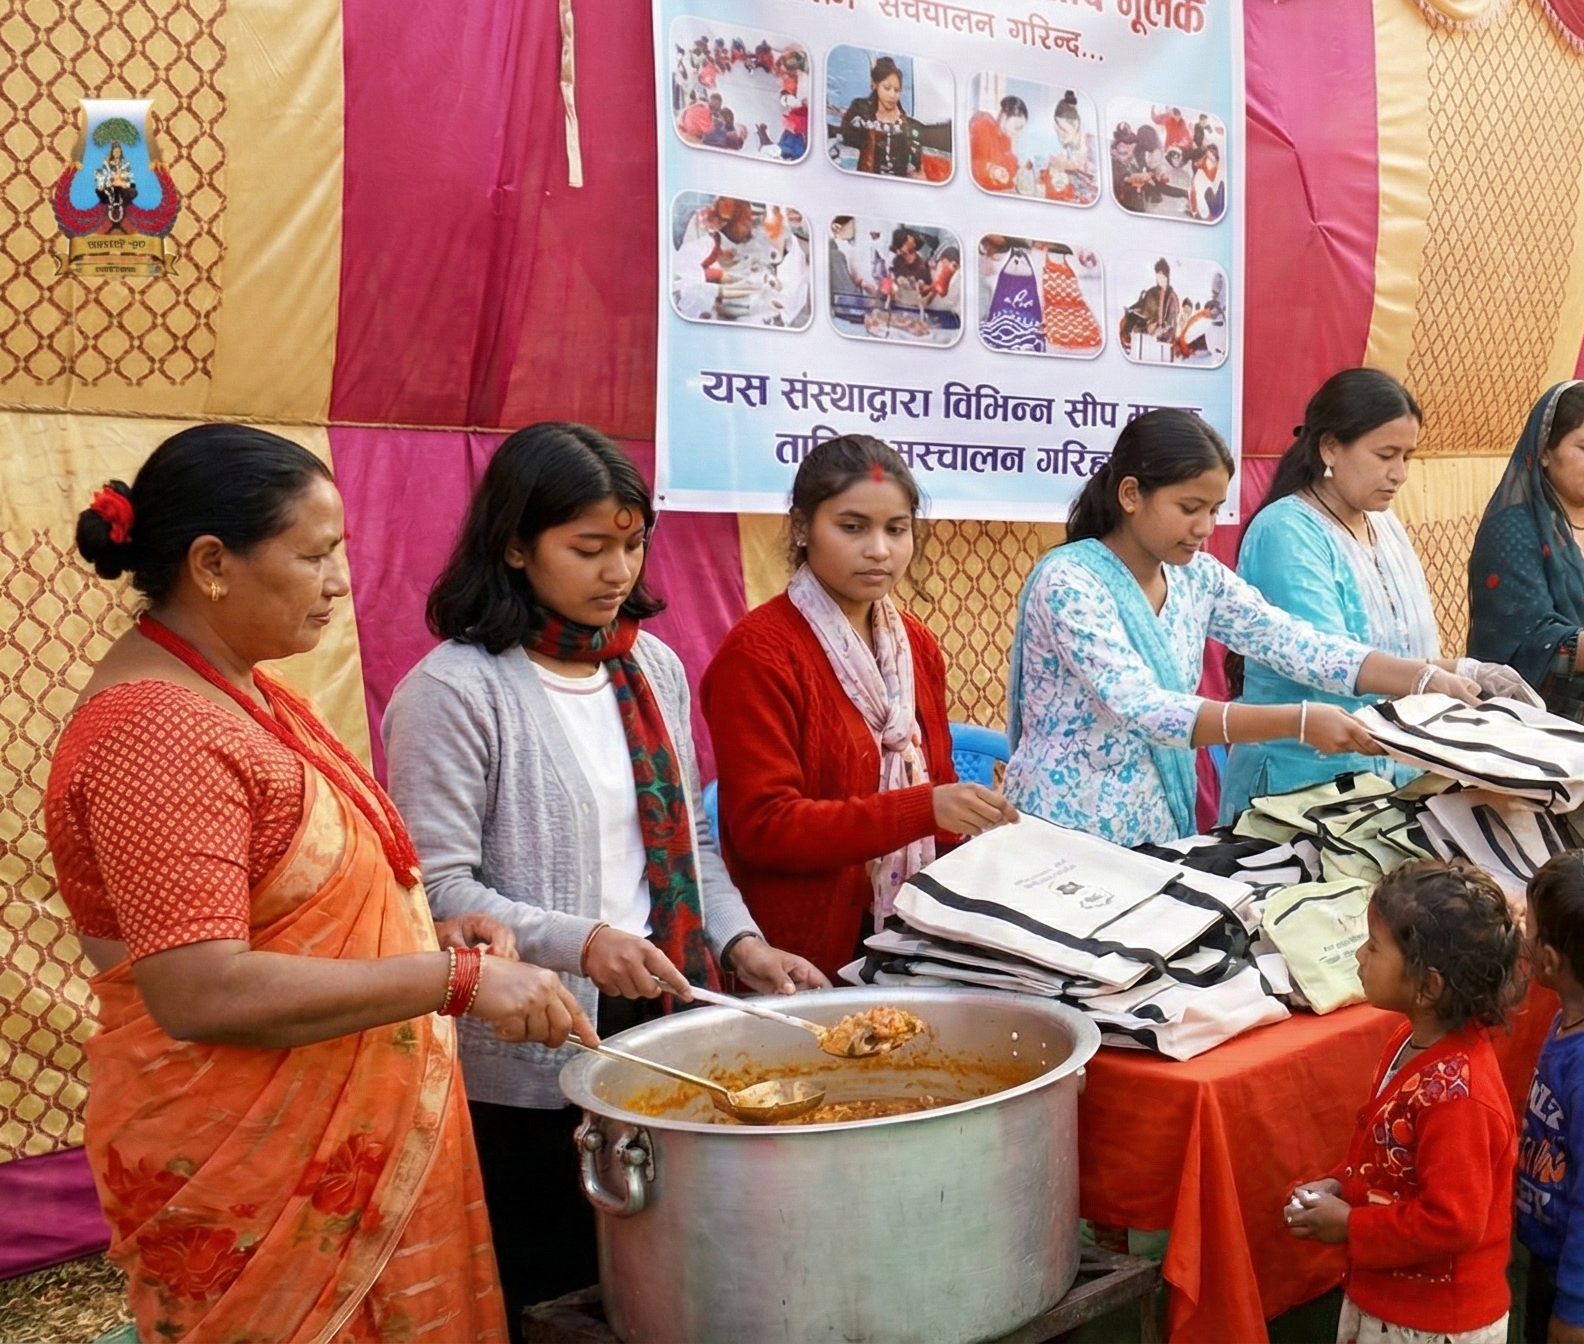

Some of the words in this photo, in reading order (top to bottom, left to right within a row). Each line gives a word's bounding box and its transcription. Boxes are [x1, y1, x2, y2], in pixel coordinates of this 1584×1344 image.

[700, 370, 770, 407] यस
[780, 371, 933, 422] संस्थाद्वारा
[943, 381, 1055, 425] विभिन्न
[1064, 392, 1119, 428] सीप
